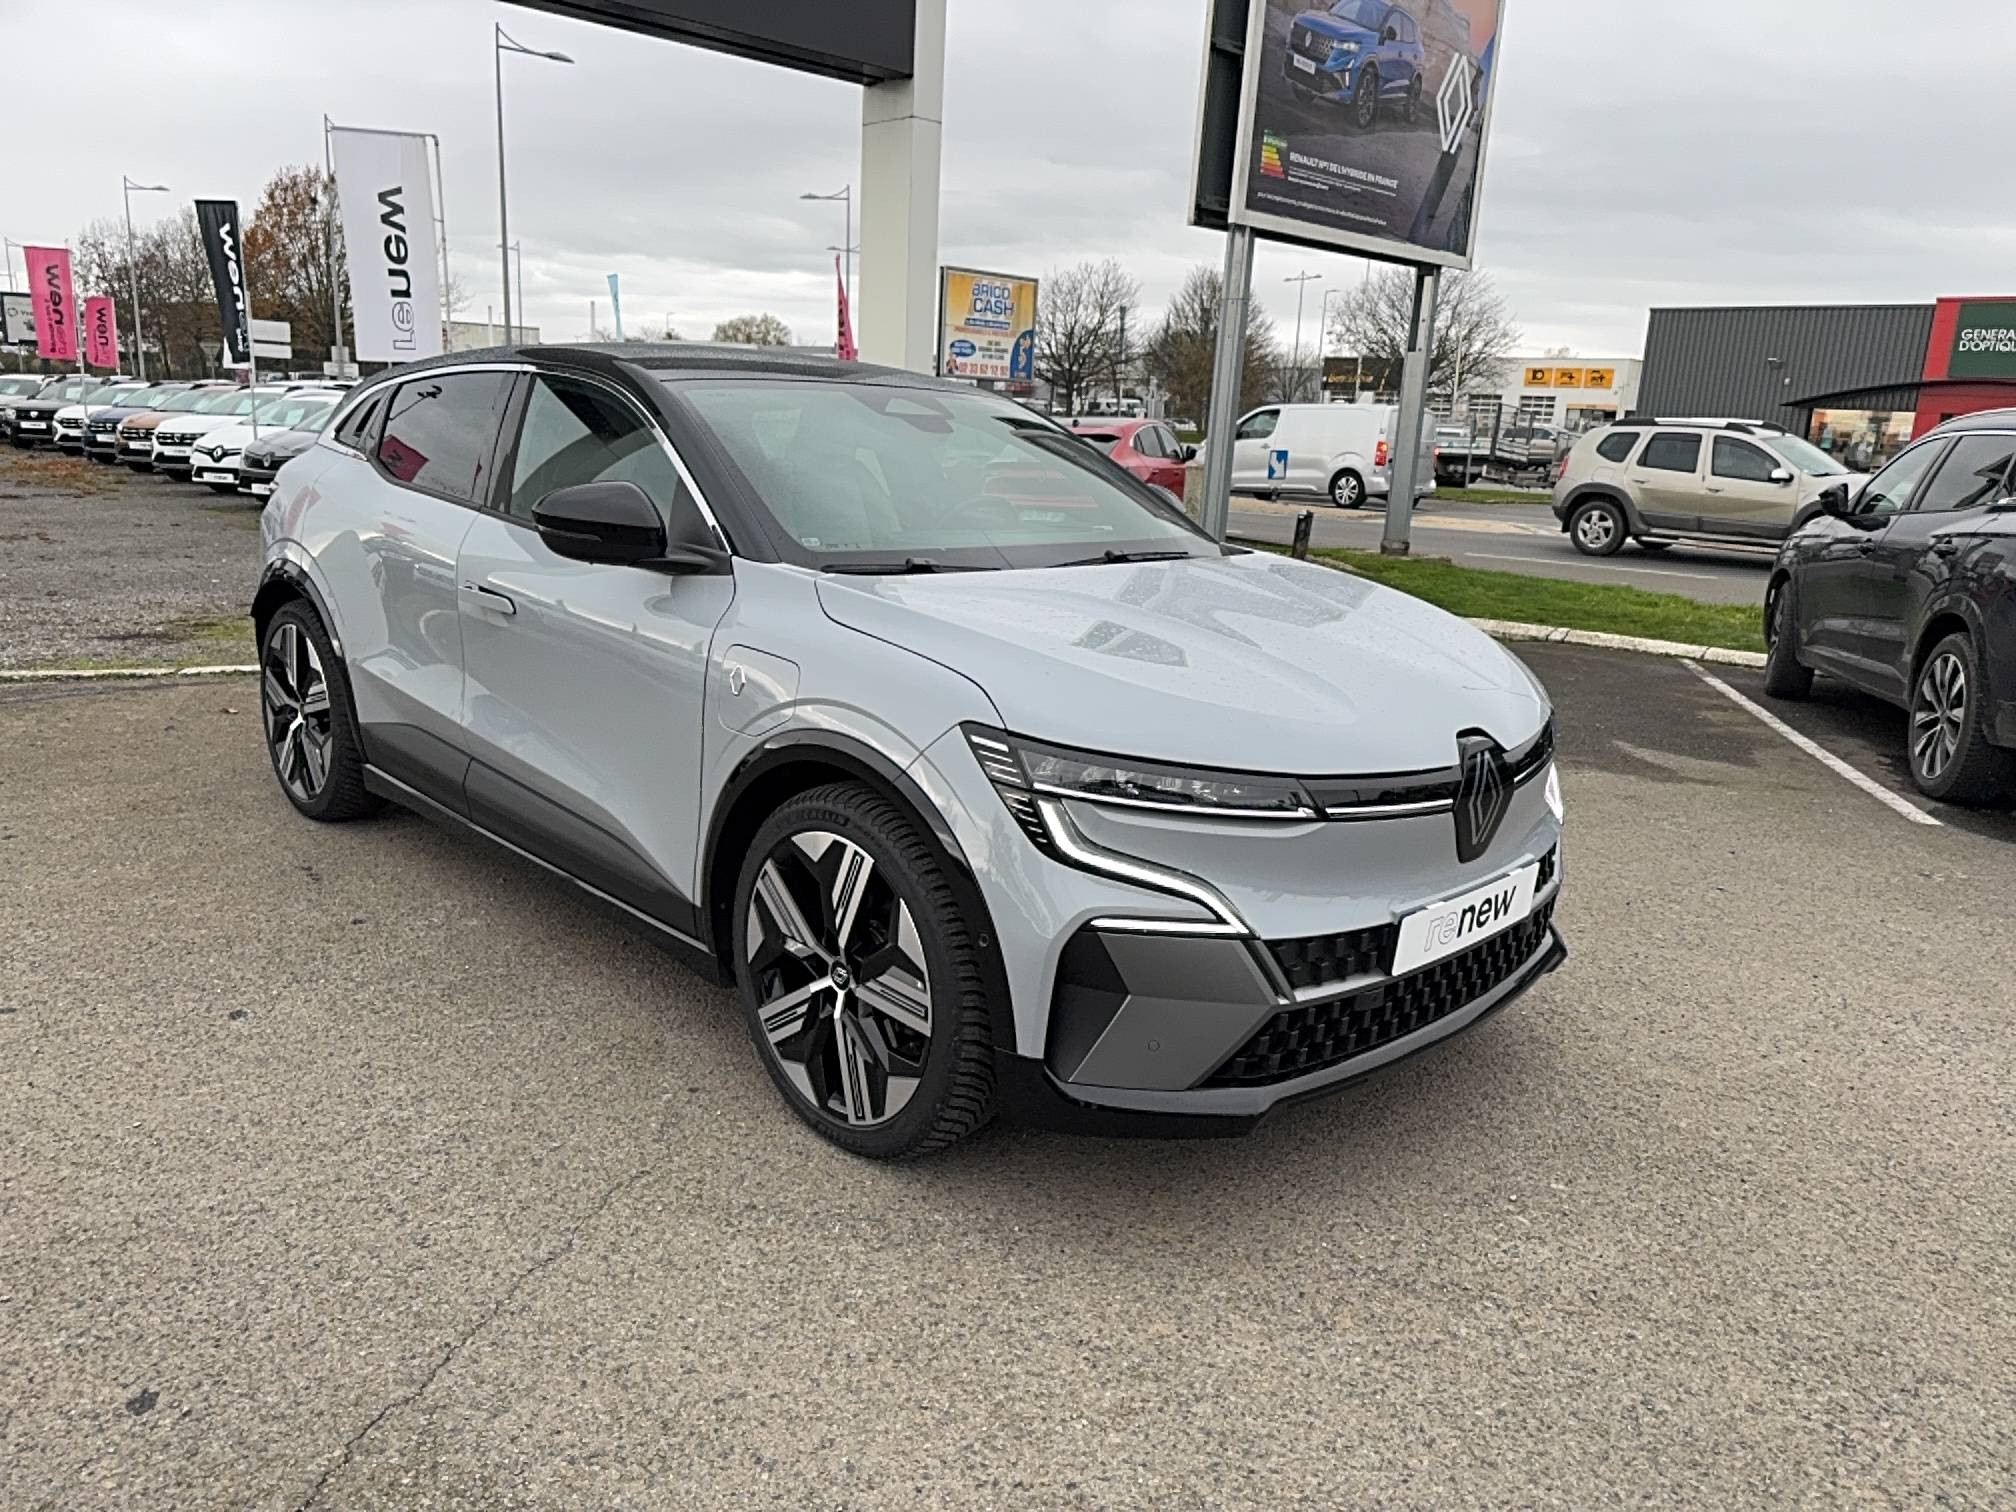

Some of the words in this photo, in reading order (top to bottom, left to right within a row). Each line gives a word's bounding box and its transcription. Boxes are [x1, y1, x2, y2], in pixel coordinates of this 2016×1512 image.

[972, 283, 1011, 300] BRICO
[973, 298, 1015, 316] CASH
[1424, 885, 1517, 953] renew
